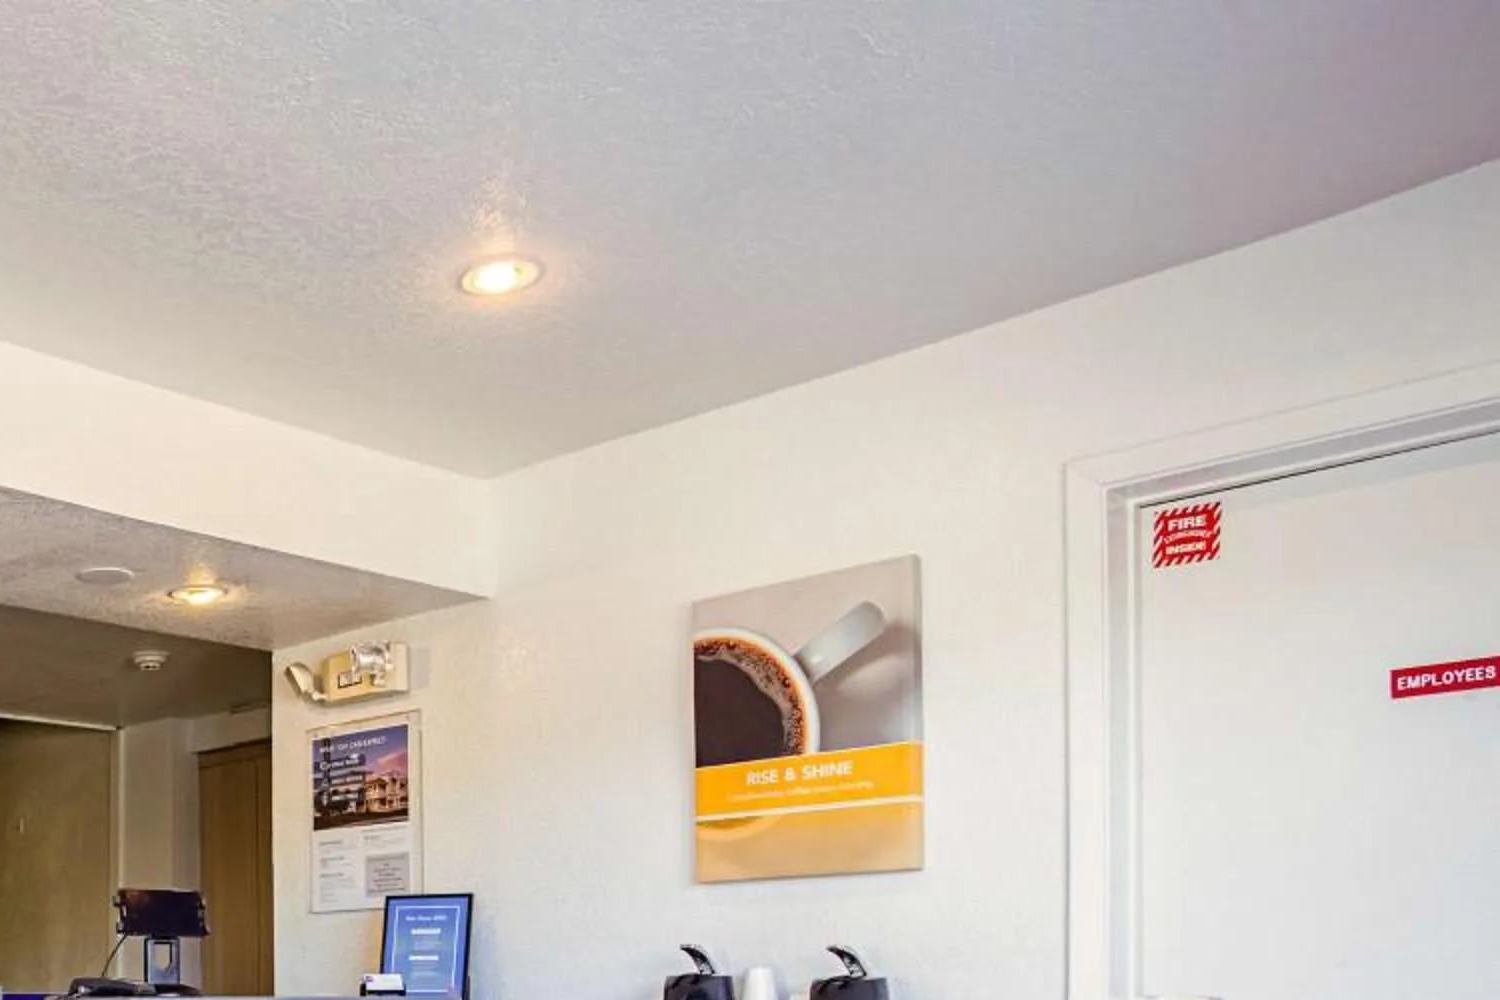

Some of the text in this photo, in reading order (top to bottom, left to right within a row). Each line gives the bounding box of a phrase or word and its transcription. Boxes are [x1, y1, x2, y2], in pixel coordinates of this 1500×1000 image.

[1167, 513, 1207, 532] FIRE
[1397, 665, 1496, 691] EMPLOYEES
[745, 761, 853, 785] RISE & SHINE
